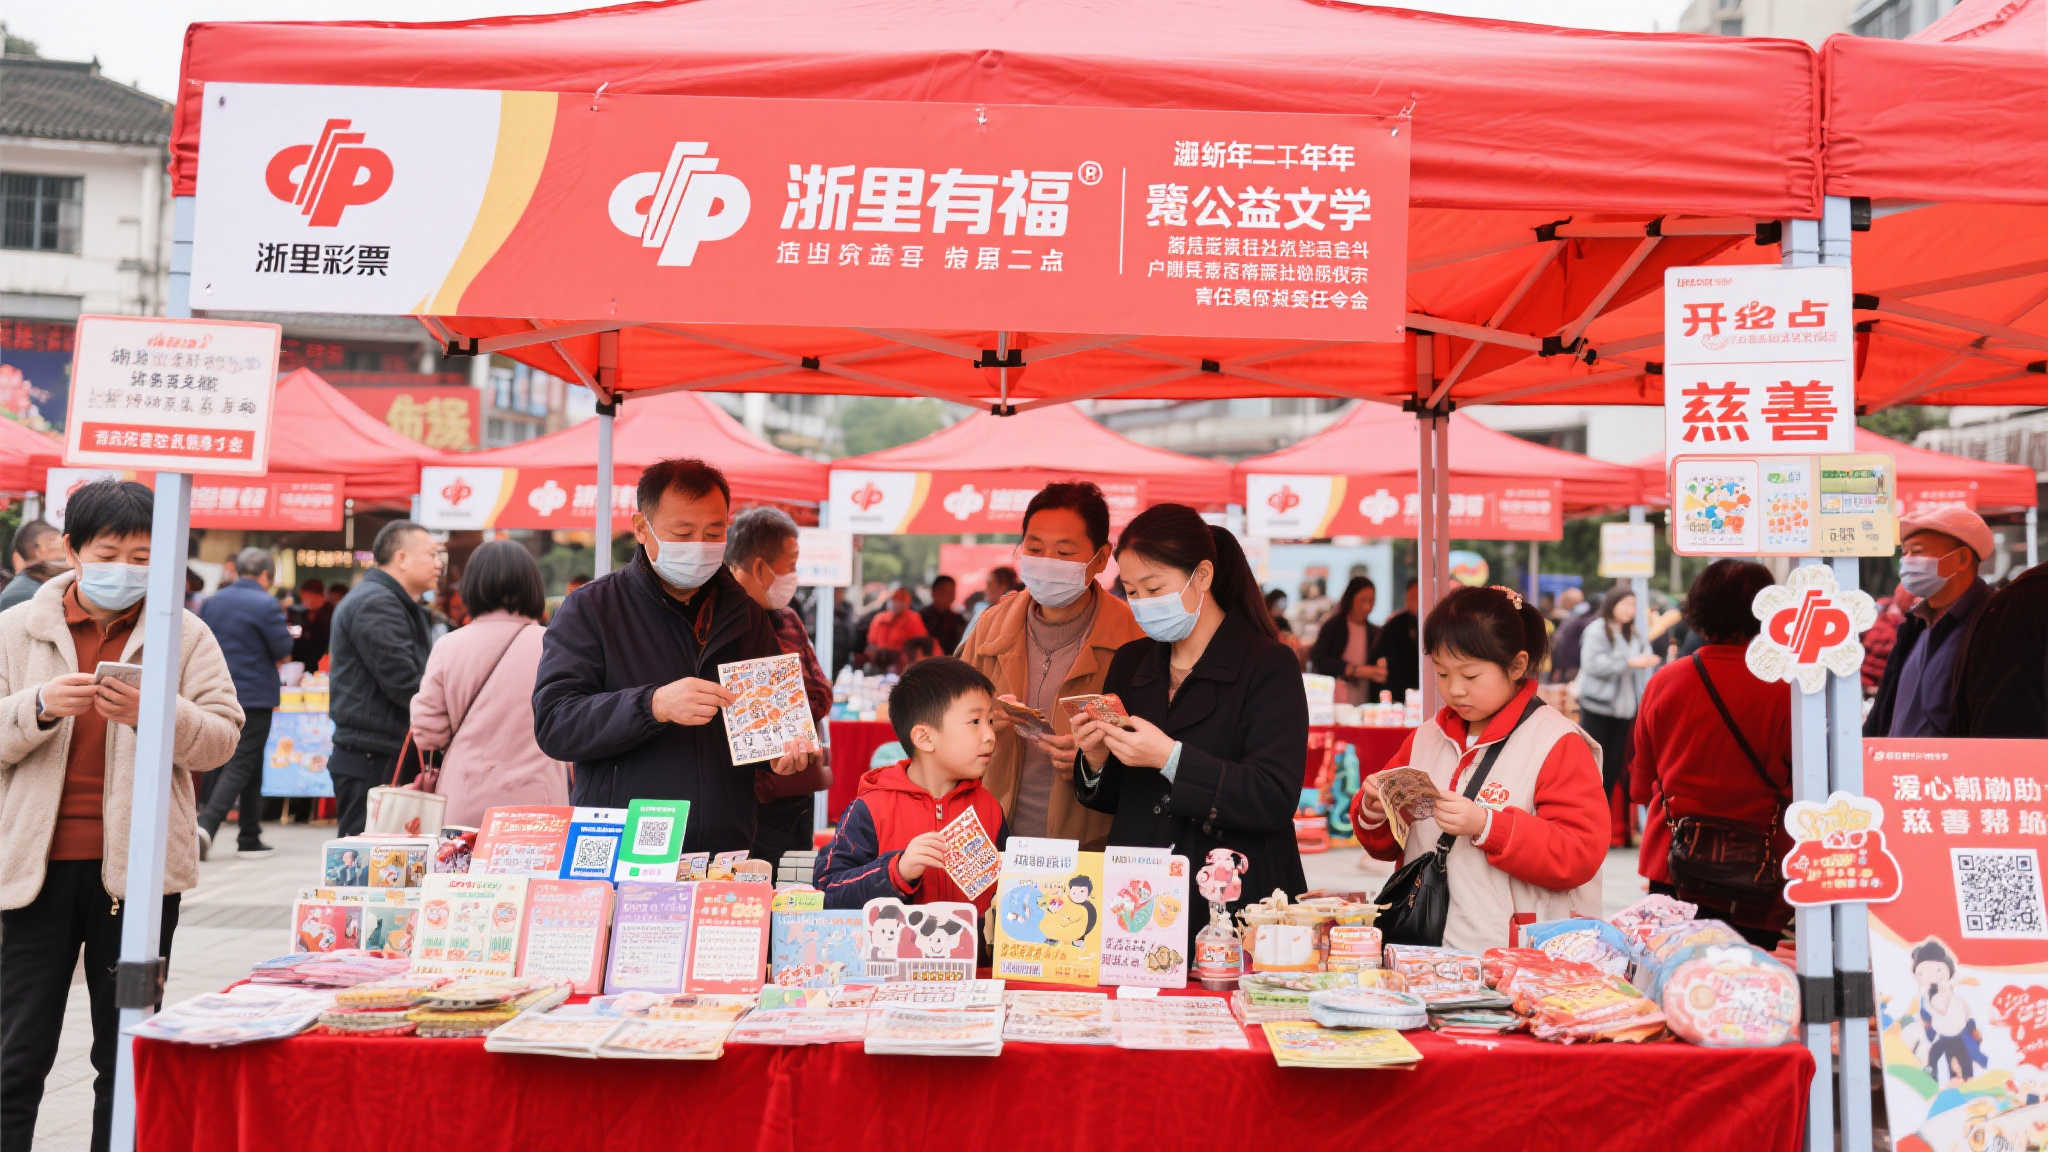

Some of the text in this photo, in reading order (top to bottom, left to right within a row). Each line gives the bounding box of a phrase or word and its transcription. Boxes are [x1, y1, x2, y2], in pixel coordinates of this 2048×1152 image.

[780, 163, 1073, 237] 浙里有福
[255, 241, 392, 277] 浙里彩票
